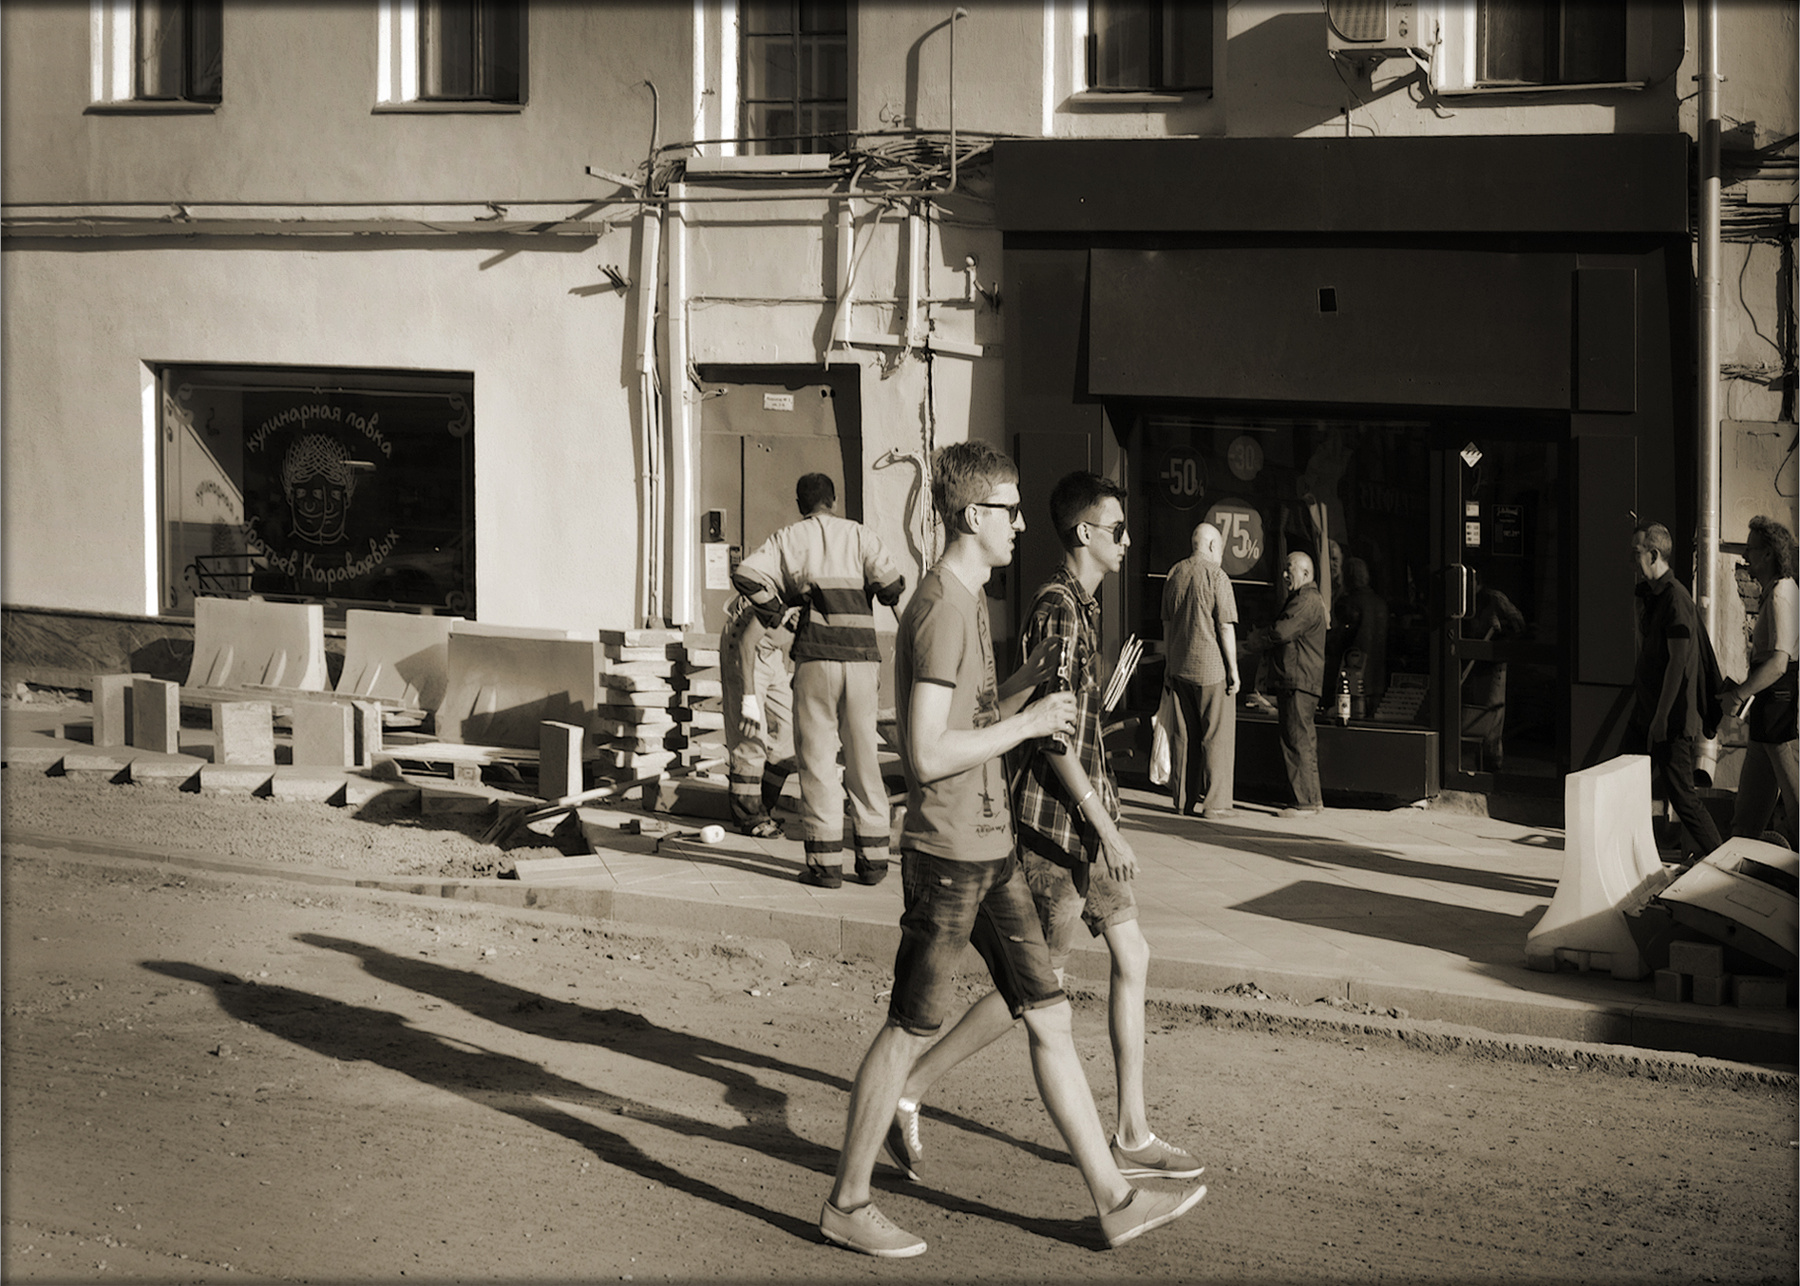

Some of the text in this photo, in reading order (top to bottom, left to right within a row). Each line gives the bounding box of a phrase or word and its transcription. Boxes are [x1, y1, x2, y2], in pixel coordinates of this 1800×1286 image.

[246, 405, 392, 458] кулинарная лавка
[1161, 458, 1204, 496] -50%
[303, 528, 400, 592] Караваевых
